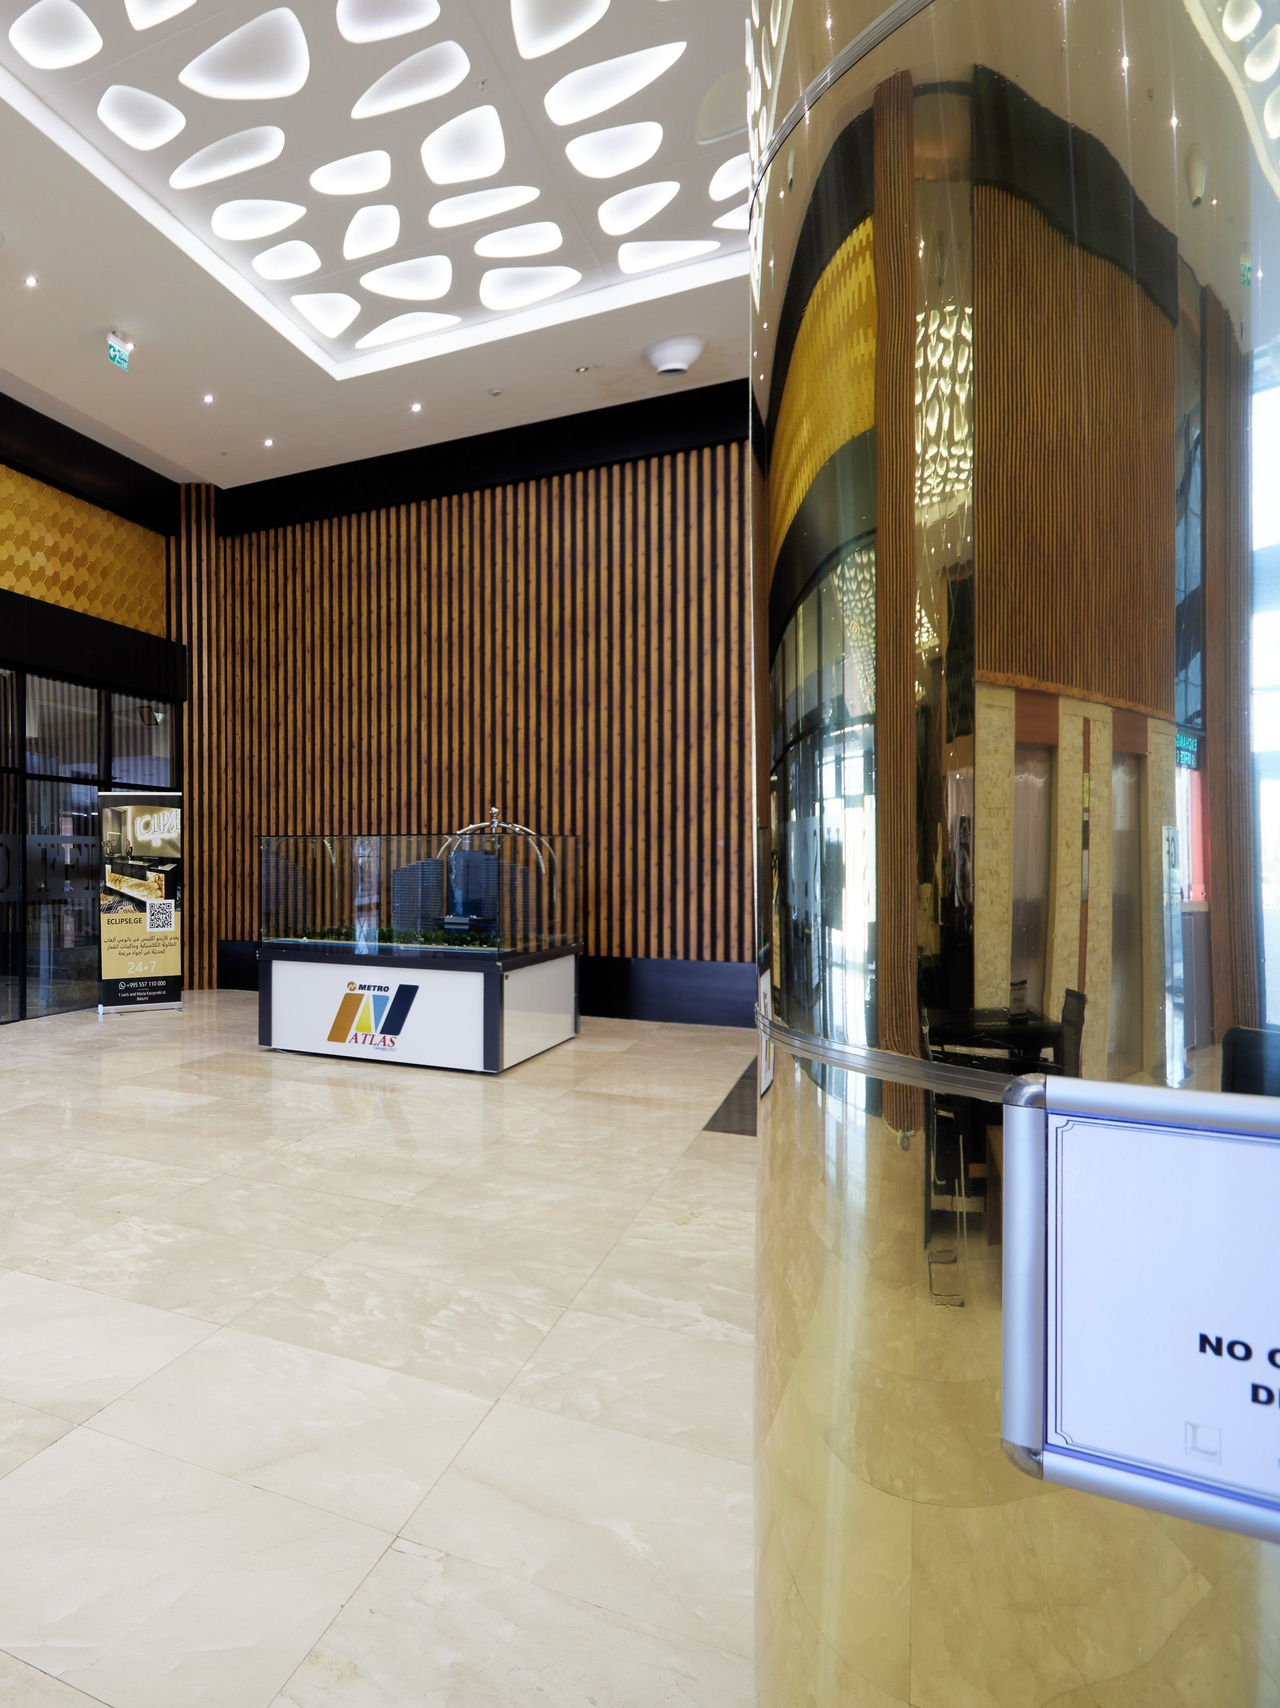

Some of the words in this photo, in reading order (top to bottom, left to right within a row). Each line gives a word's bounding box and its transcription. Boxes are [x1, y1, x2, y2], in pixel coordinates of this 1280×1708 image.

[358, 984, 390, 992] METRO
[348, 1032, 397, 1048] ATLAS
[1199, 1332, 1253, 1362] NO
[1251, 1382, 1280, 1410] D
